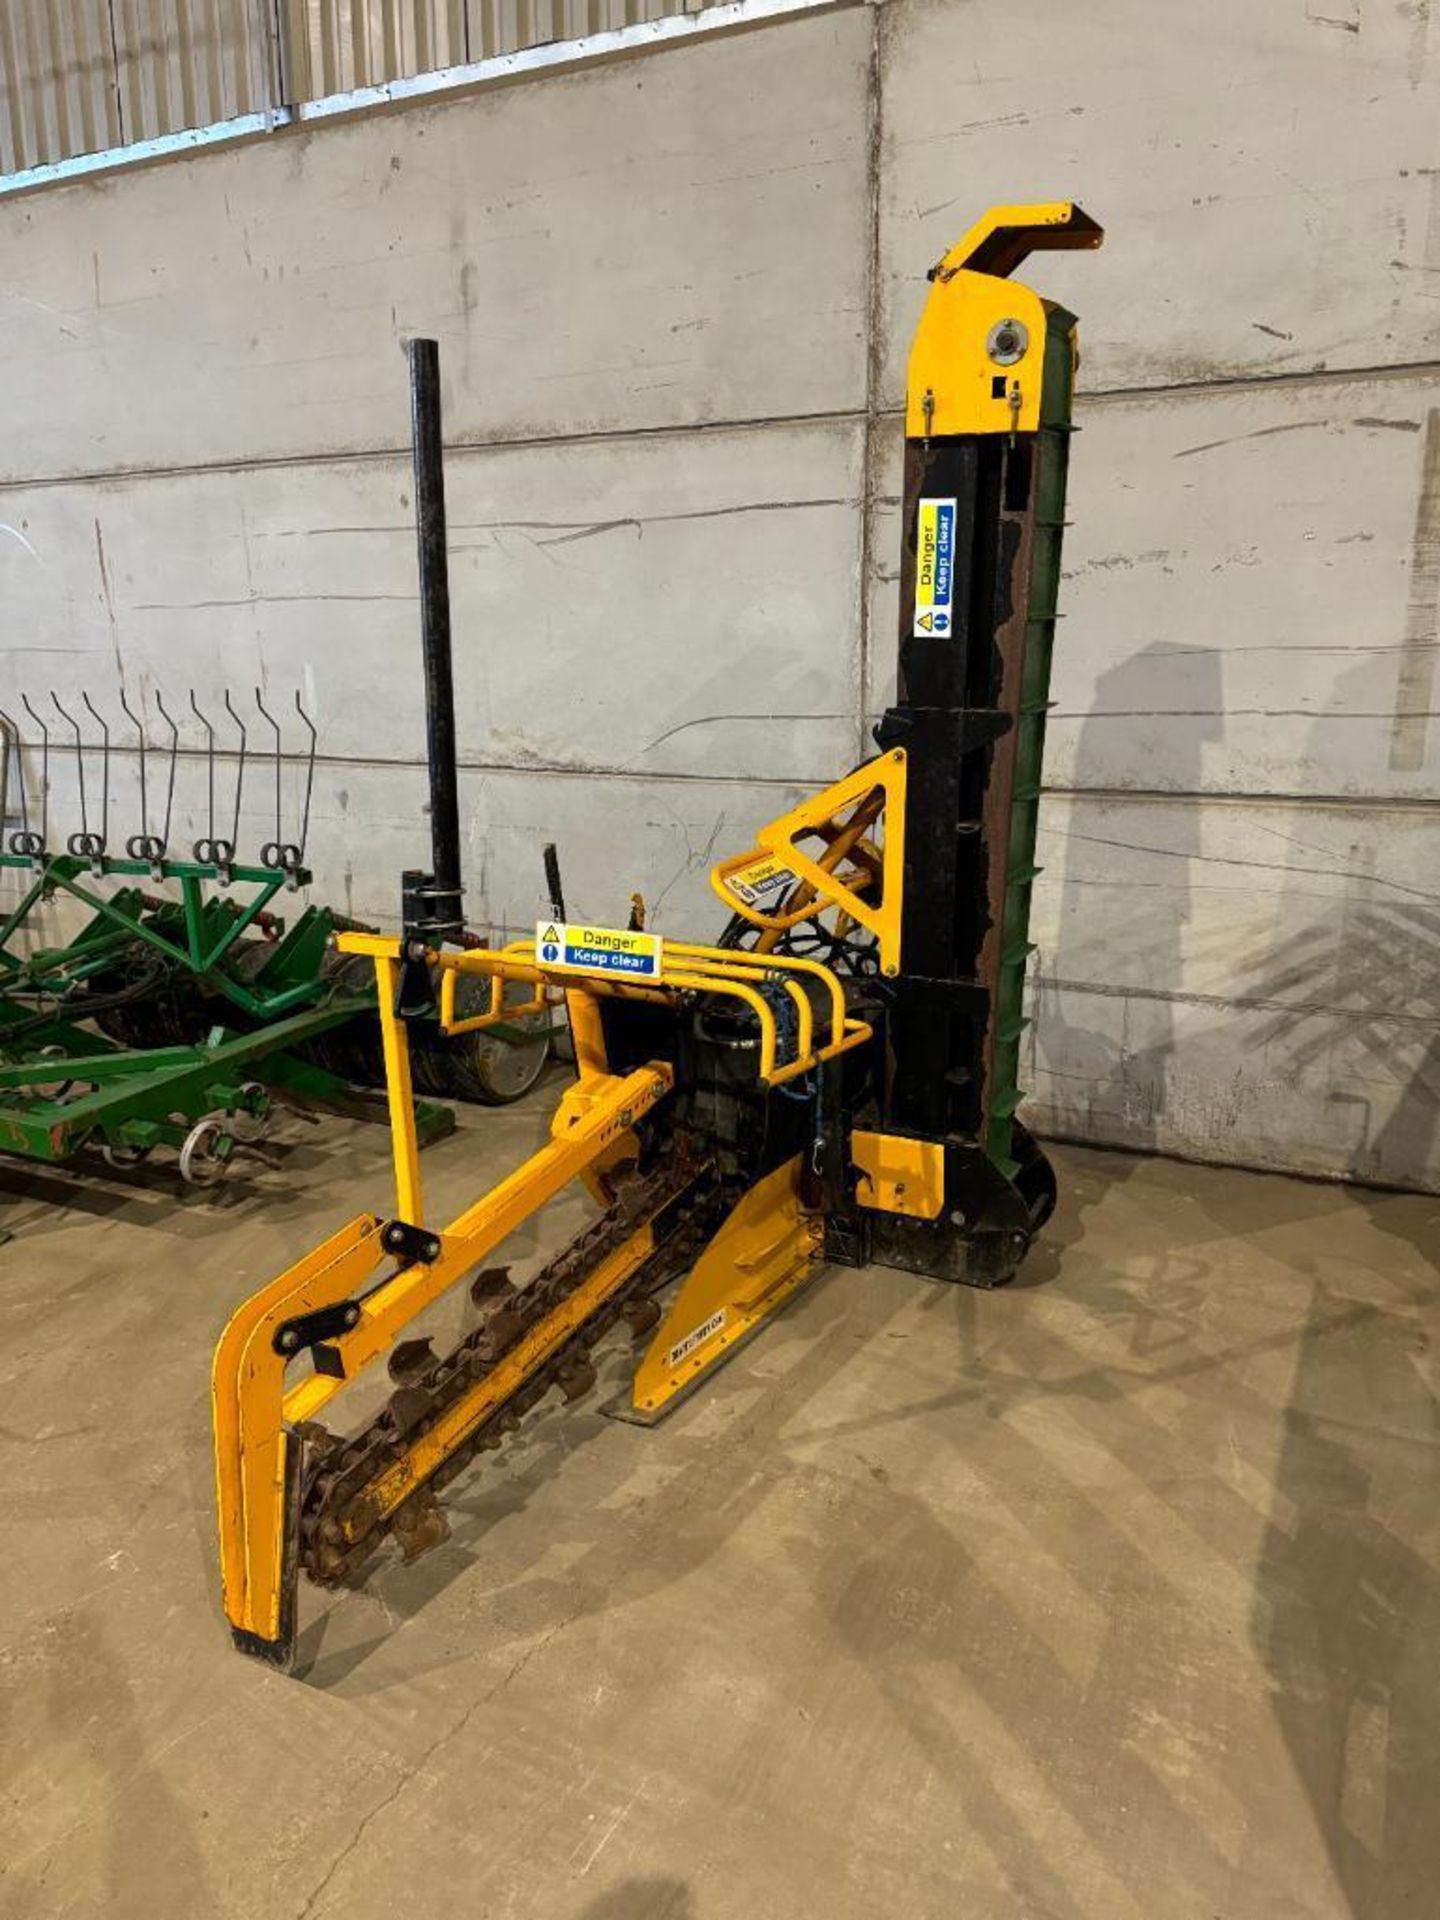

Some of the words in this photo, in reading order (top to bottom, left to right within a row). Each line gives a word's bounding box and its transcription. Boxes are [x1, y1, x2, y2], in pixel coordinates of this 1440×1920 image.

[938, 514, 950, 552] clear
[921, 525, 935, 585] Danger
[936, 557, 950, 595] Keep
[573, 949, 608, 966] Keep
[611, 955, 645, 968] clear
[583, 931, 638, 950] Danger
